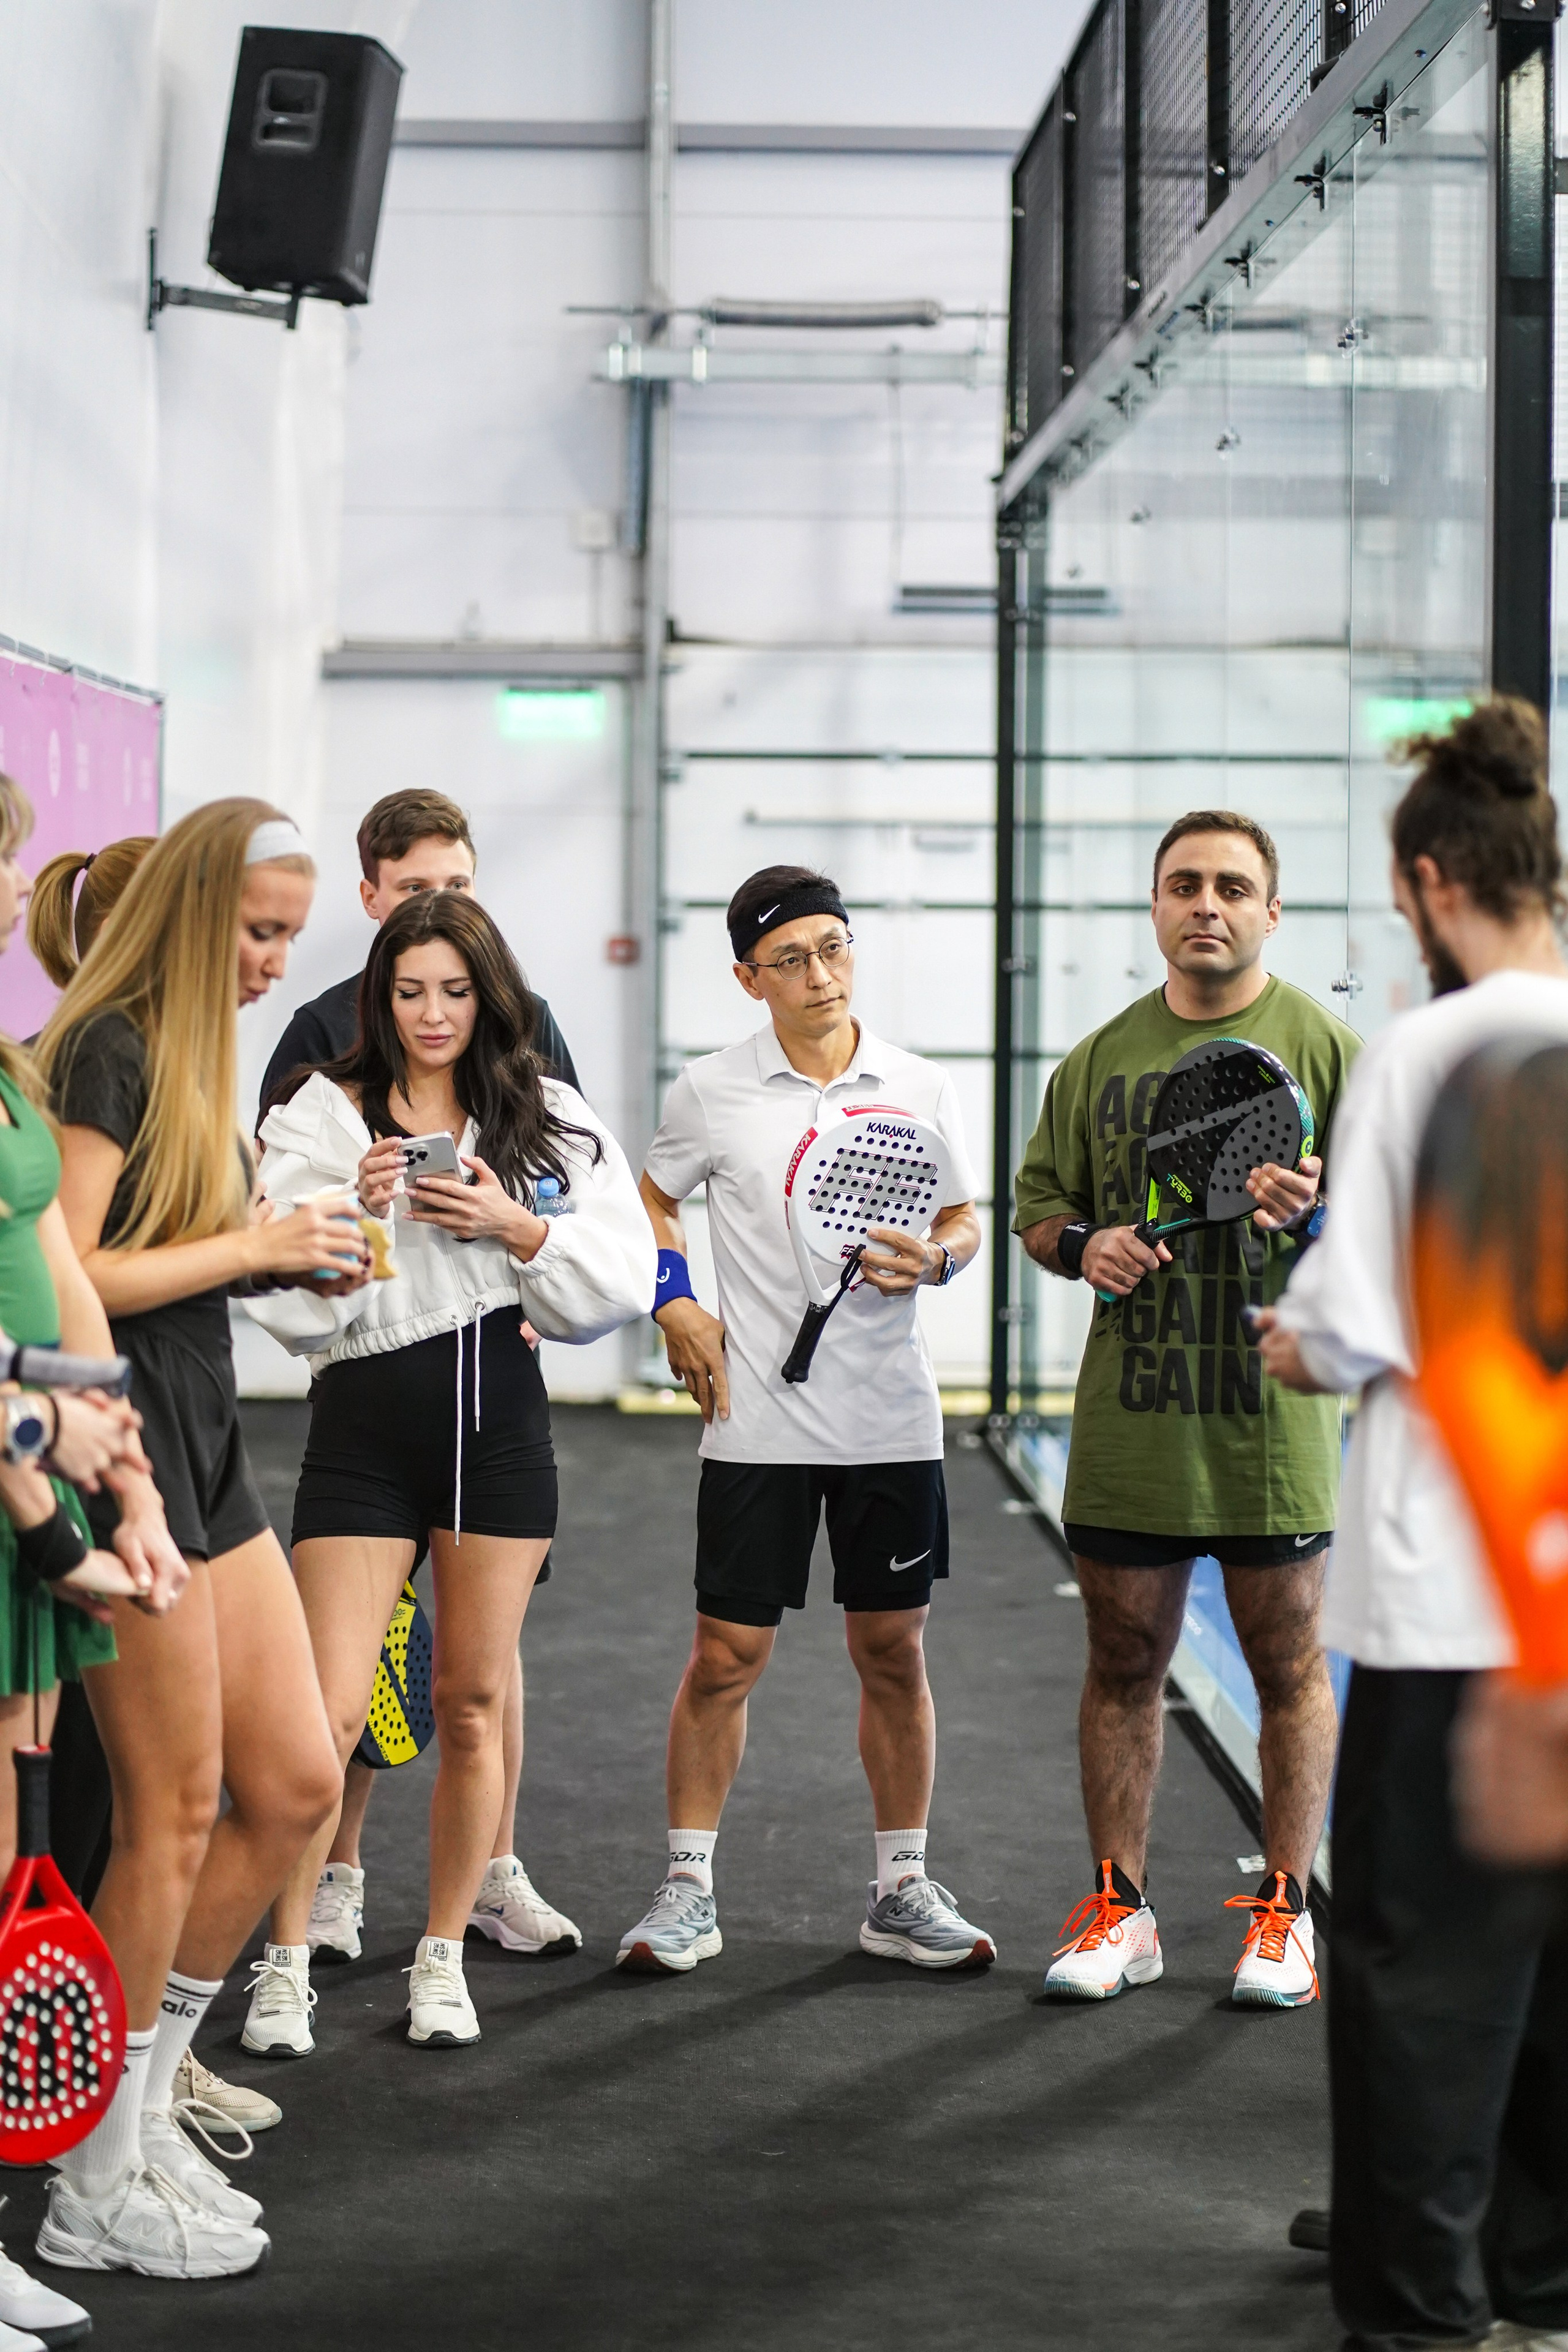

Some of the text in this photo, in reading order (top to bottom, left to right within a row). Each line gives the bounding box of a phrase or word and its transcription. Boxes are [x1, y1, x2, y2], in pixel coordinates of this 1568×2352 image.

[866, 1121, 917, 1140] KARAKAL
[1166, 1173, 1193, 1204] TURBO
[1119, 1345, 1262, 1414] GAIN
[160, 2000, 197, 2018] alo
